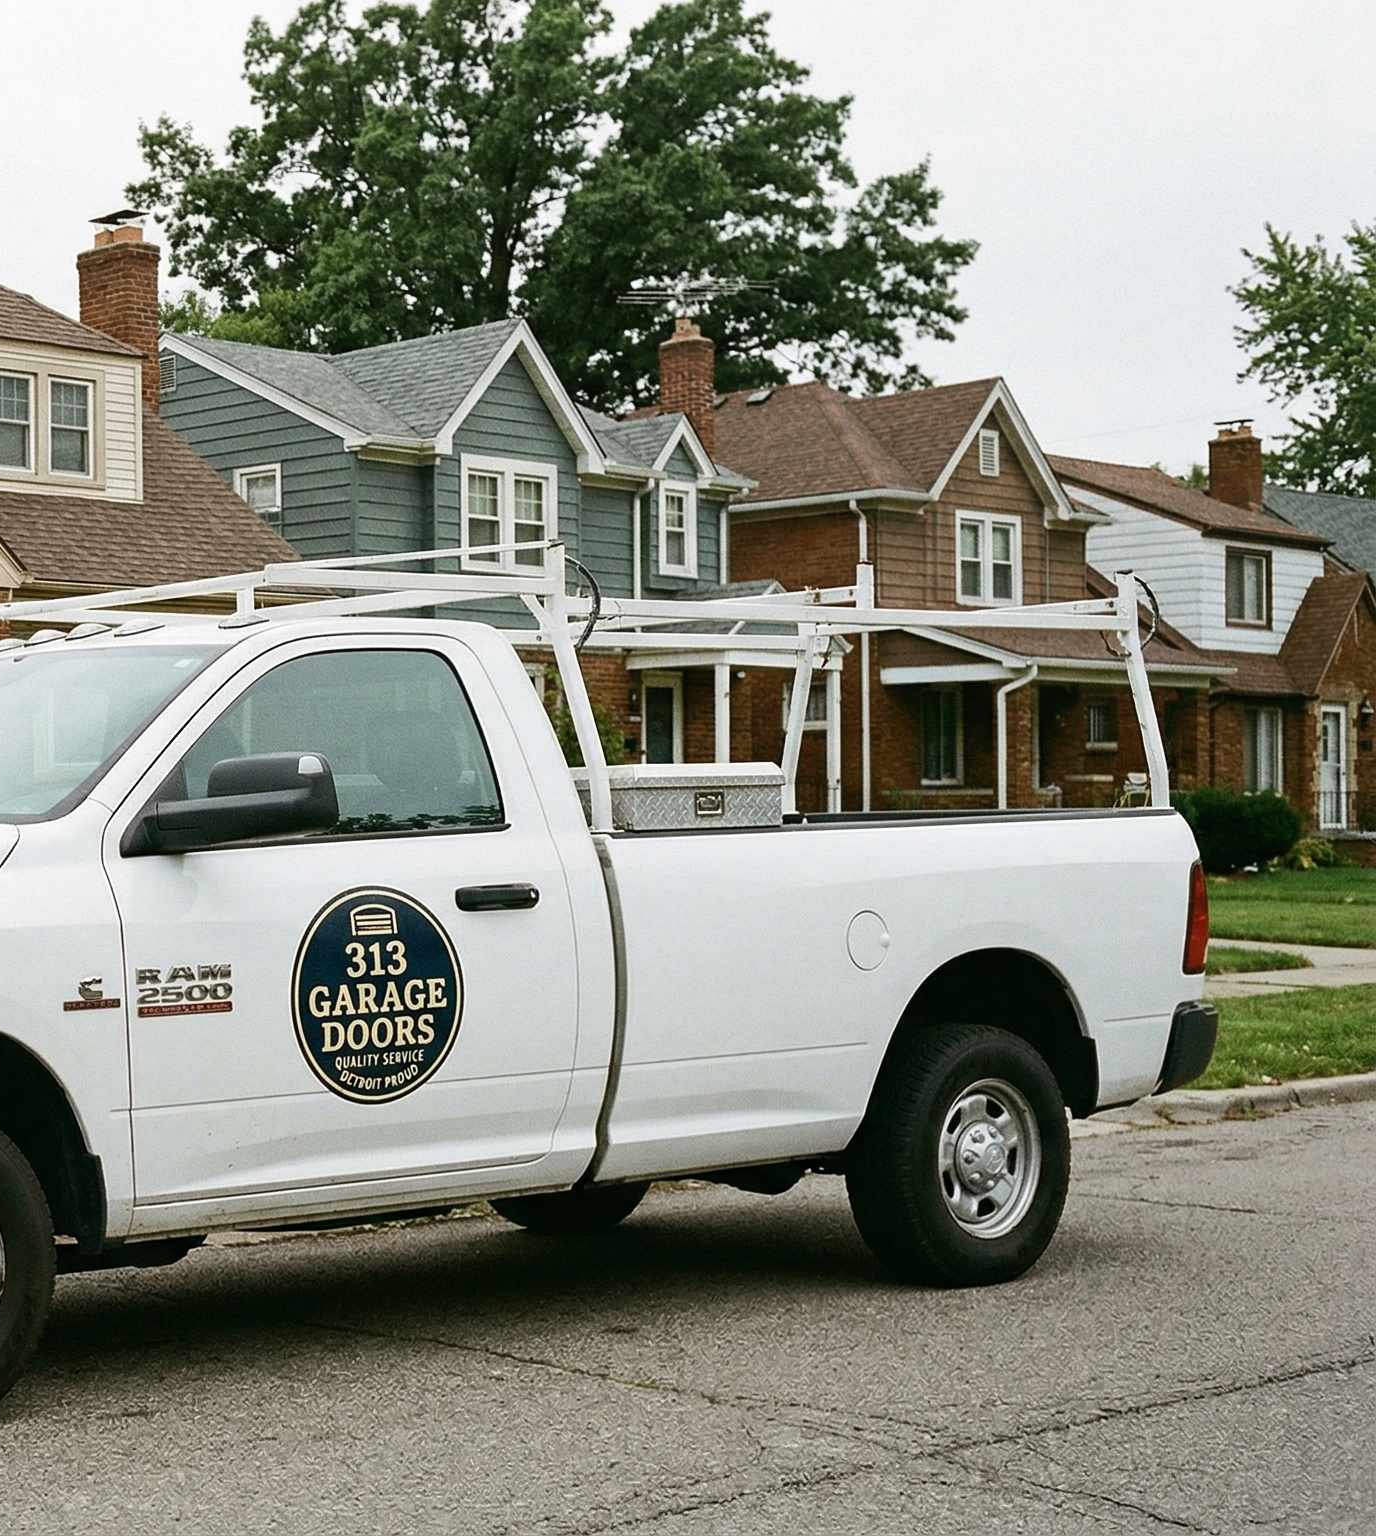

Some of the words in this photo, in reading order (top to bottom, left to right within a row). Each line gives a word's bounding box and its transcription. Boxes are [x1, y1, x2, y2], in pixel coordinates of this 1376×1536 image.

[345, 940, 407, 978] 313
[136, 963, 232, 985] RAM
[136, 982, 233, 1004] 2500
[308, 978, 447, 1018] GARAGE
[321, 1014, 435, 1052] DOORS
[335, 1053, 380, 1071] QUALITY
[384, 1064, 419, 1088] PROUD
